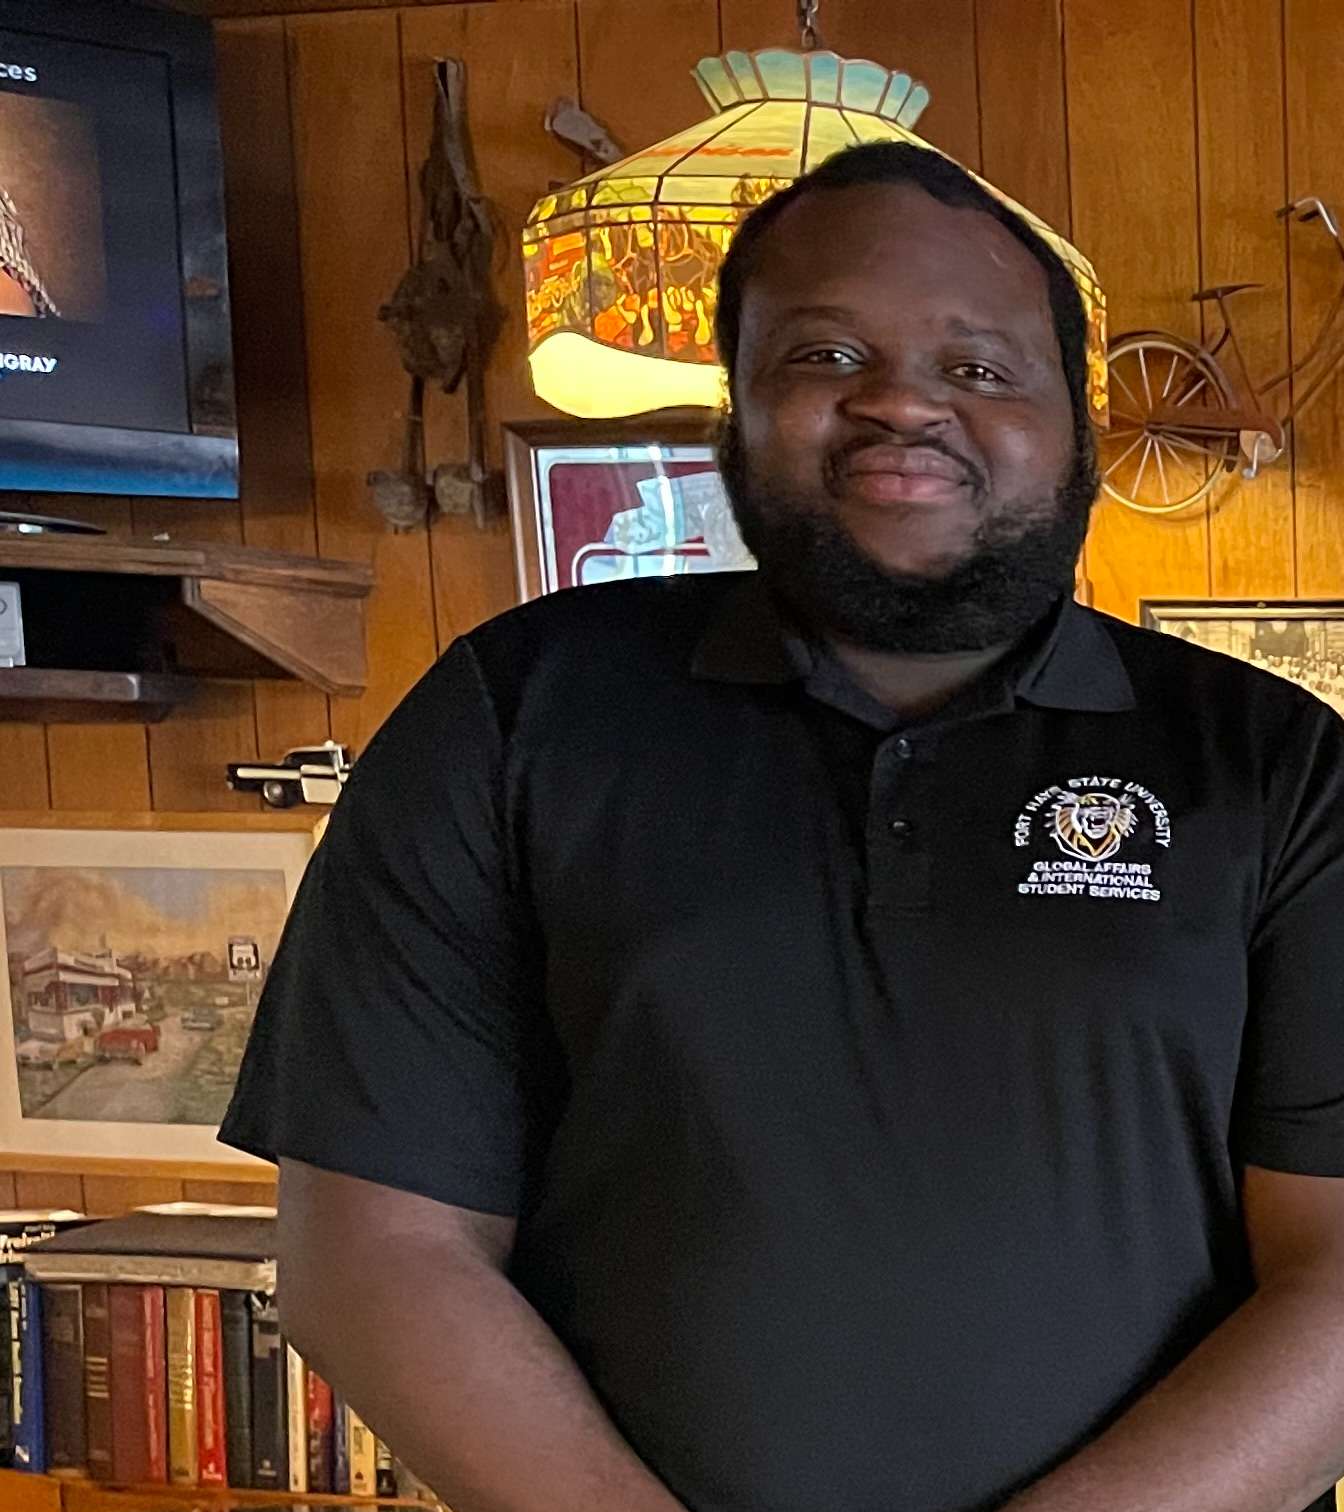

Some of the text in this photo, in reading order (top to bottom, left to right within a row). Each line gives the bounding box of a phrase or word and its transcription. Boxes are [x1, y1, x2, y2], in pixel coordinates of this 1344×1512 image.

[0, 352, 58, 373] GRAY
[1013, 813, 1032, 847] FORT
[1067, 776, 1122, 788] STATE
[1124, 782, 1171, 848] UNIVERSITY
[1033, 861, 1152, 875] GLOBAL AFFAIRS
[1027, 872, 1153, 888] & INTERNATIONAL
[1018, 883, 1161, 901] STUDENT SERVICES
